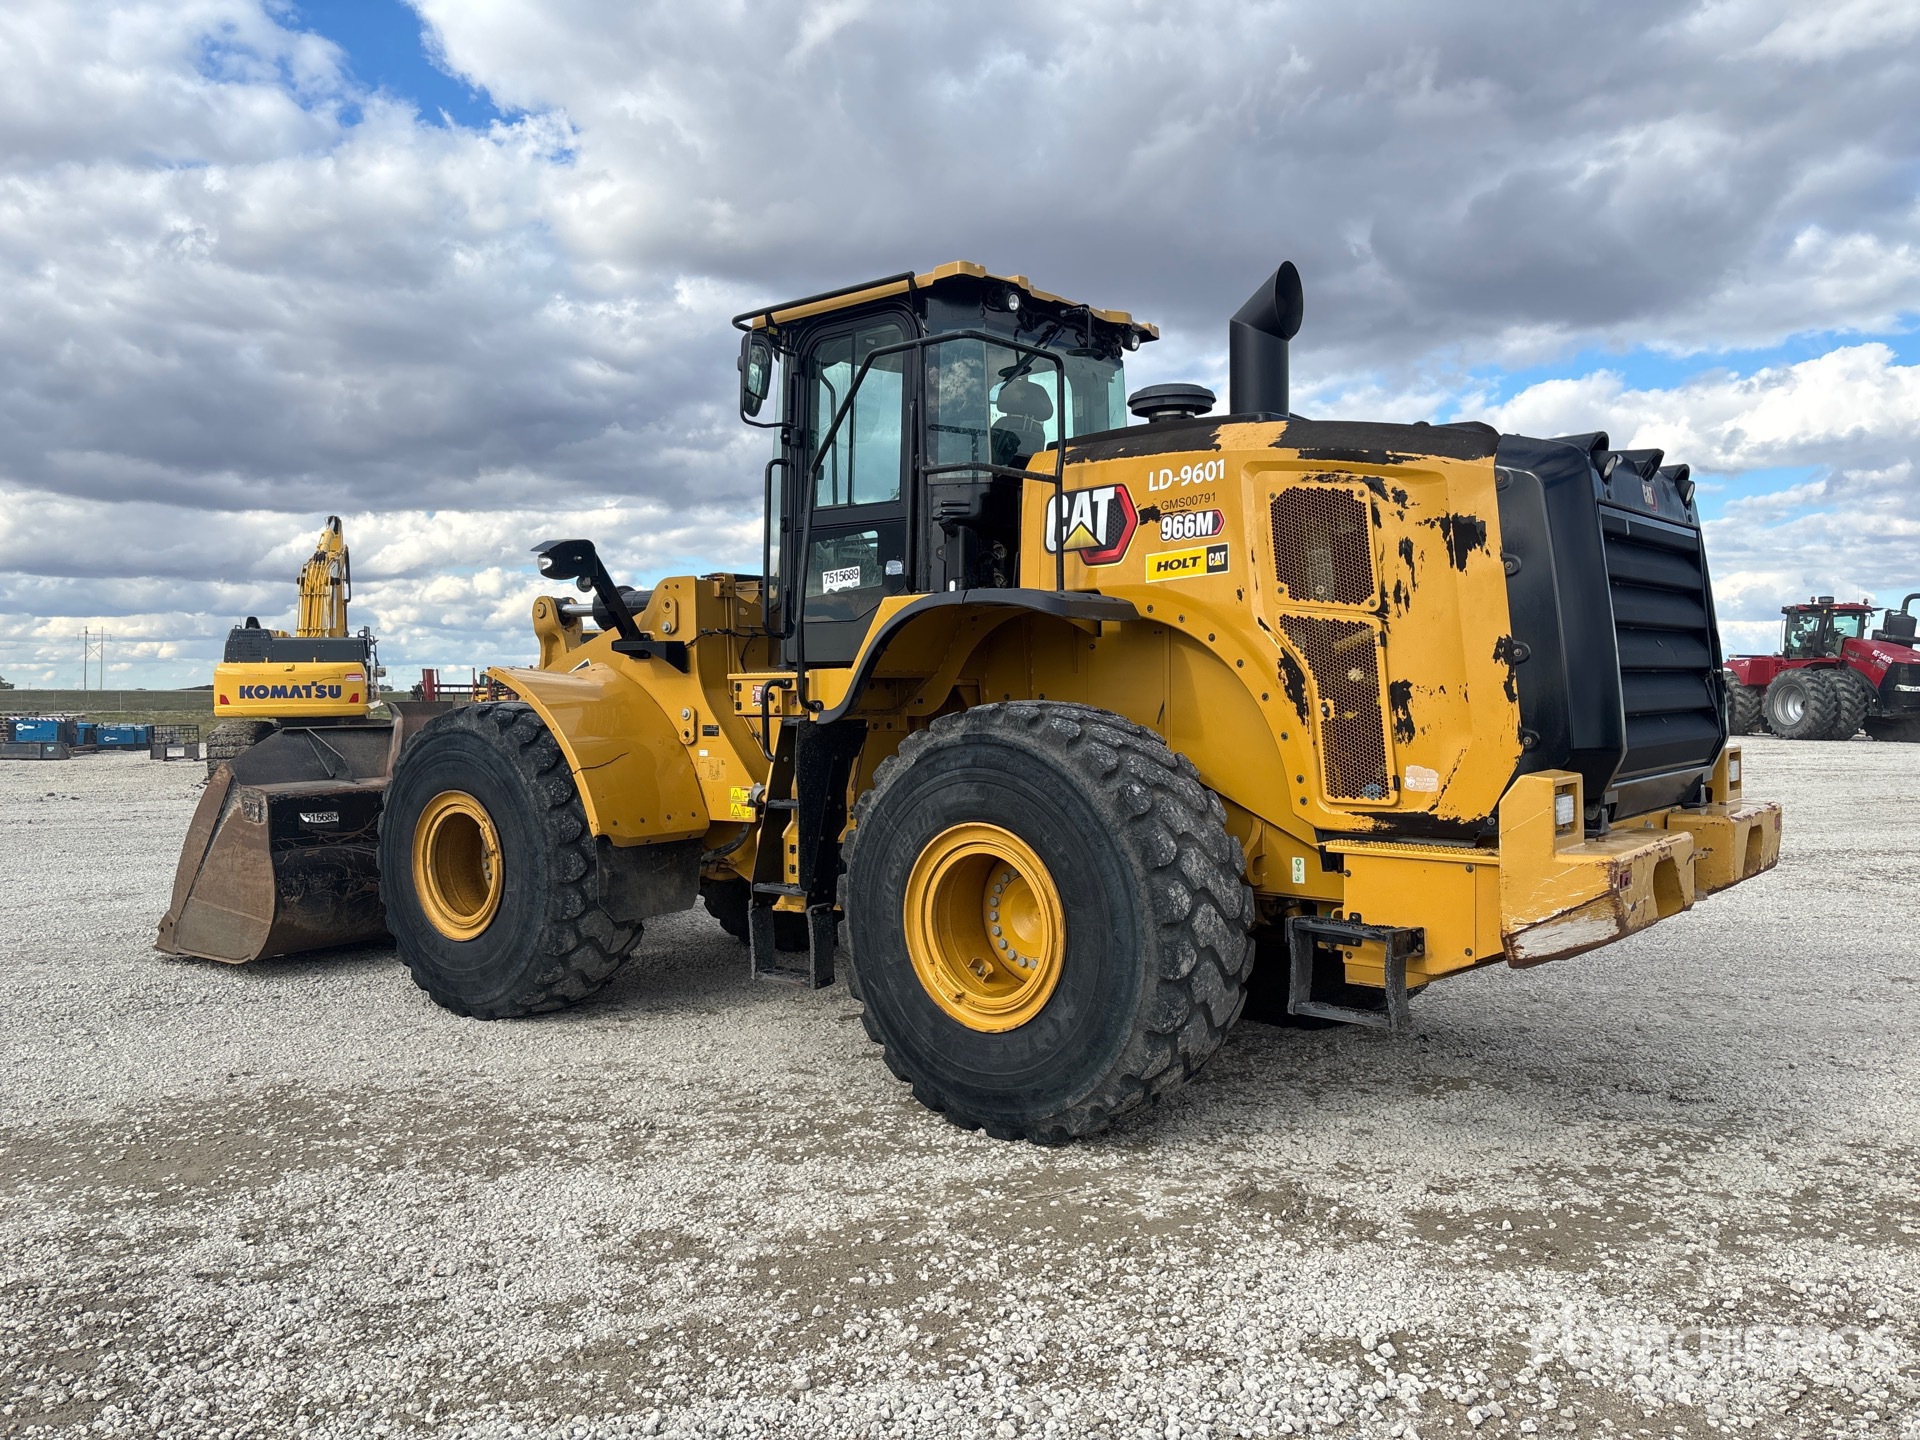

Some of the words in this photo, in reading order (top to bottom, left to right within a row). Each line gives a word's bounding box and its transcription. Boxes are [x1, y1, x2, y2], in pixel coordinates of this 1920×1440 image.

[1148, 458, 1225, 492] LD-9601
[1160, 491, 1216, 511] GMS00791
[1046, 486, 1115, 553] CAT
[1161, 510, 1214, 540] 966M
[1156, 555, 1202, 573] HOLT
[1208, 551, 1226, 567] CAT
[823, 567, 859, 585] 7515689
[239, 681, 342, 699] KOMATSU
